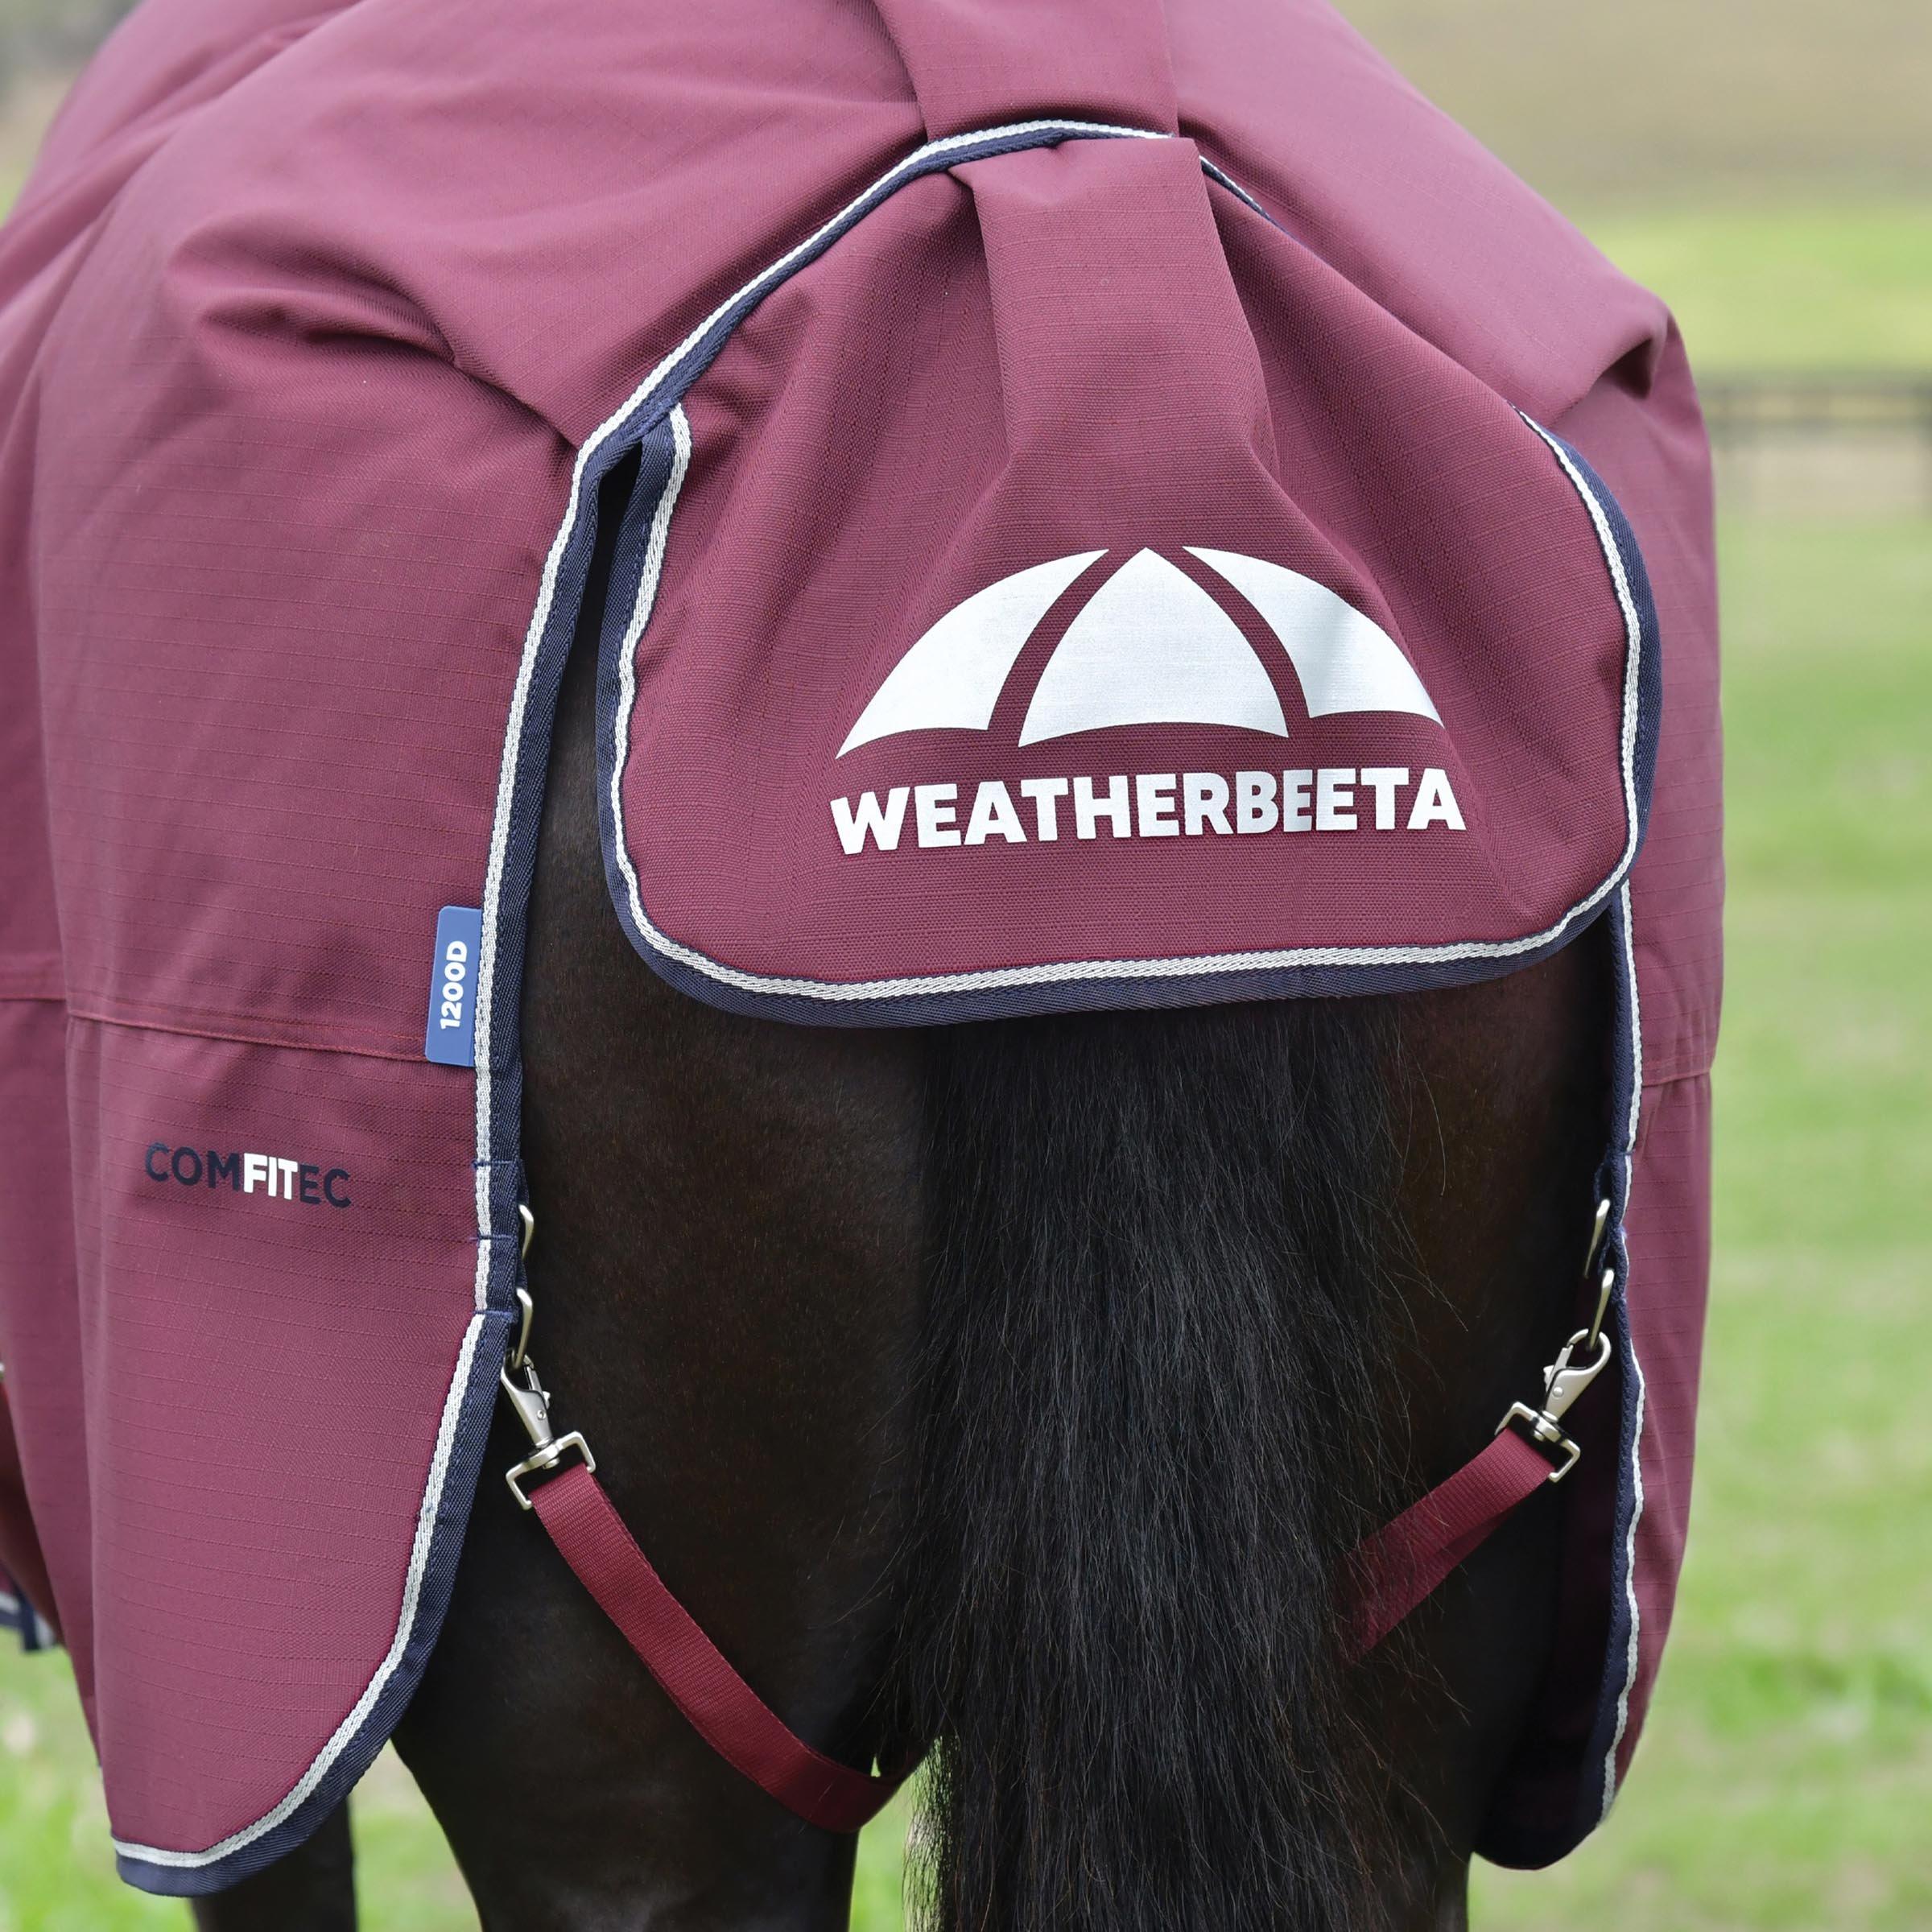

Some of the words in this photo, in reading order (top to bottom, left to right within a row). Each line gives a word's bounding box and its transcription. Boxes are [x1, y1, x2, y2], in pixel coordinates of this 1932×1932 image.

[830, 767, 1467, 855] WEATHERBEETA
[440, 940, 468, 1030] 1200D
[145, 1142, 352, 1208] COMFITEC
